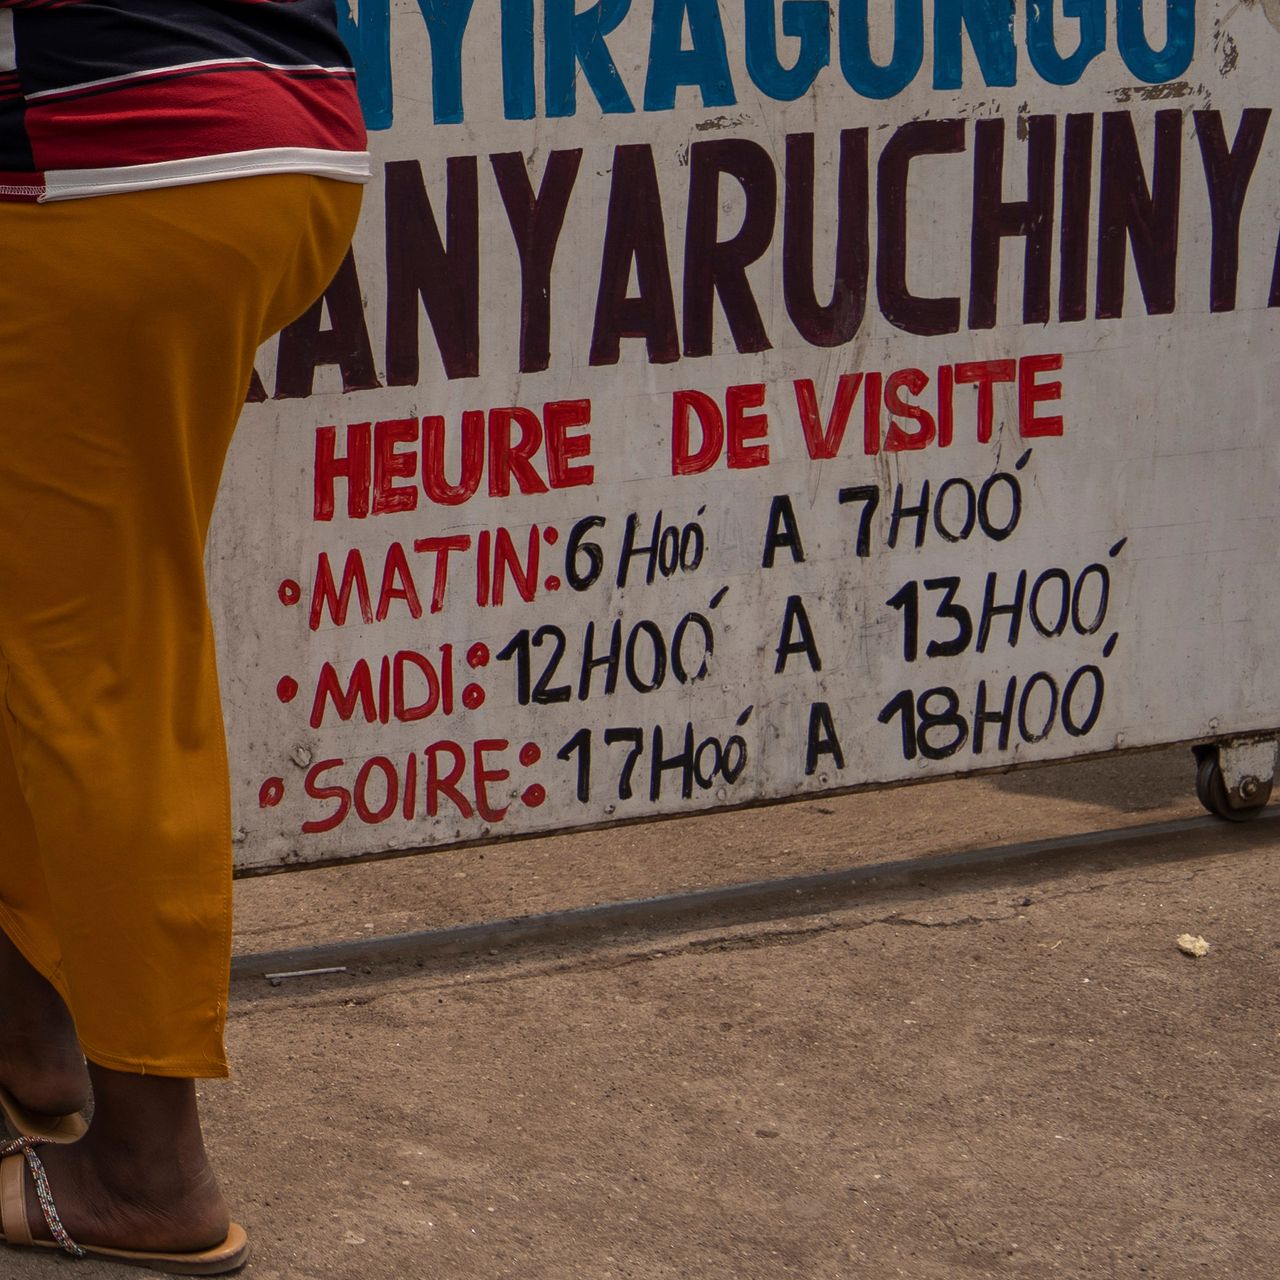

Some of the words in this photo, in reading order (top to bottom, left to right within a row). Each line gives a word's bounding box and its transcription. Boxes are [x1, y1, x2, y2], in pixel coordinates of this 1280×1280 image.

[240, 107, 1280, 403] ANYARUCHINY
[314, 399, 594, 521] HEURE
[673, 384, 770, 476] DE
[794, 354, 1063, 459] VISITE
[762, 495, 805, 568] A
[775, 595, 822, 674] A
[805, 702, 845, 775] A
